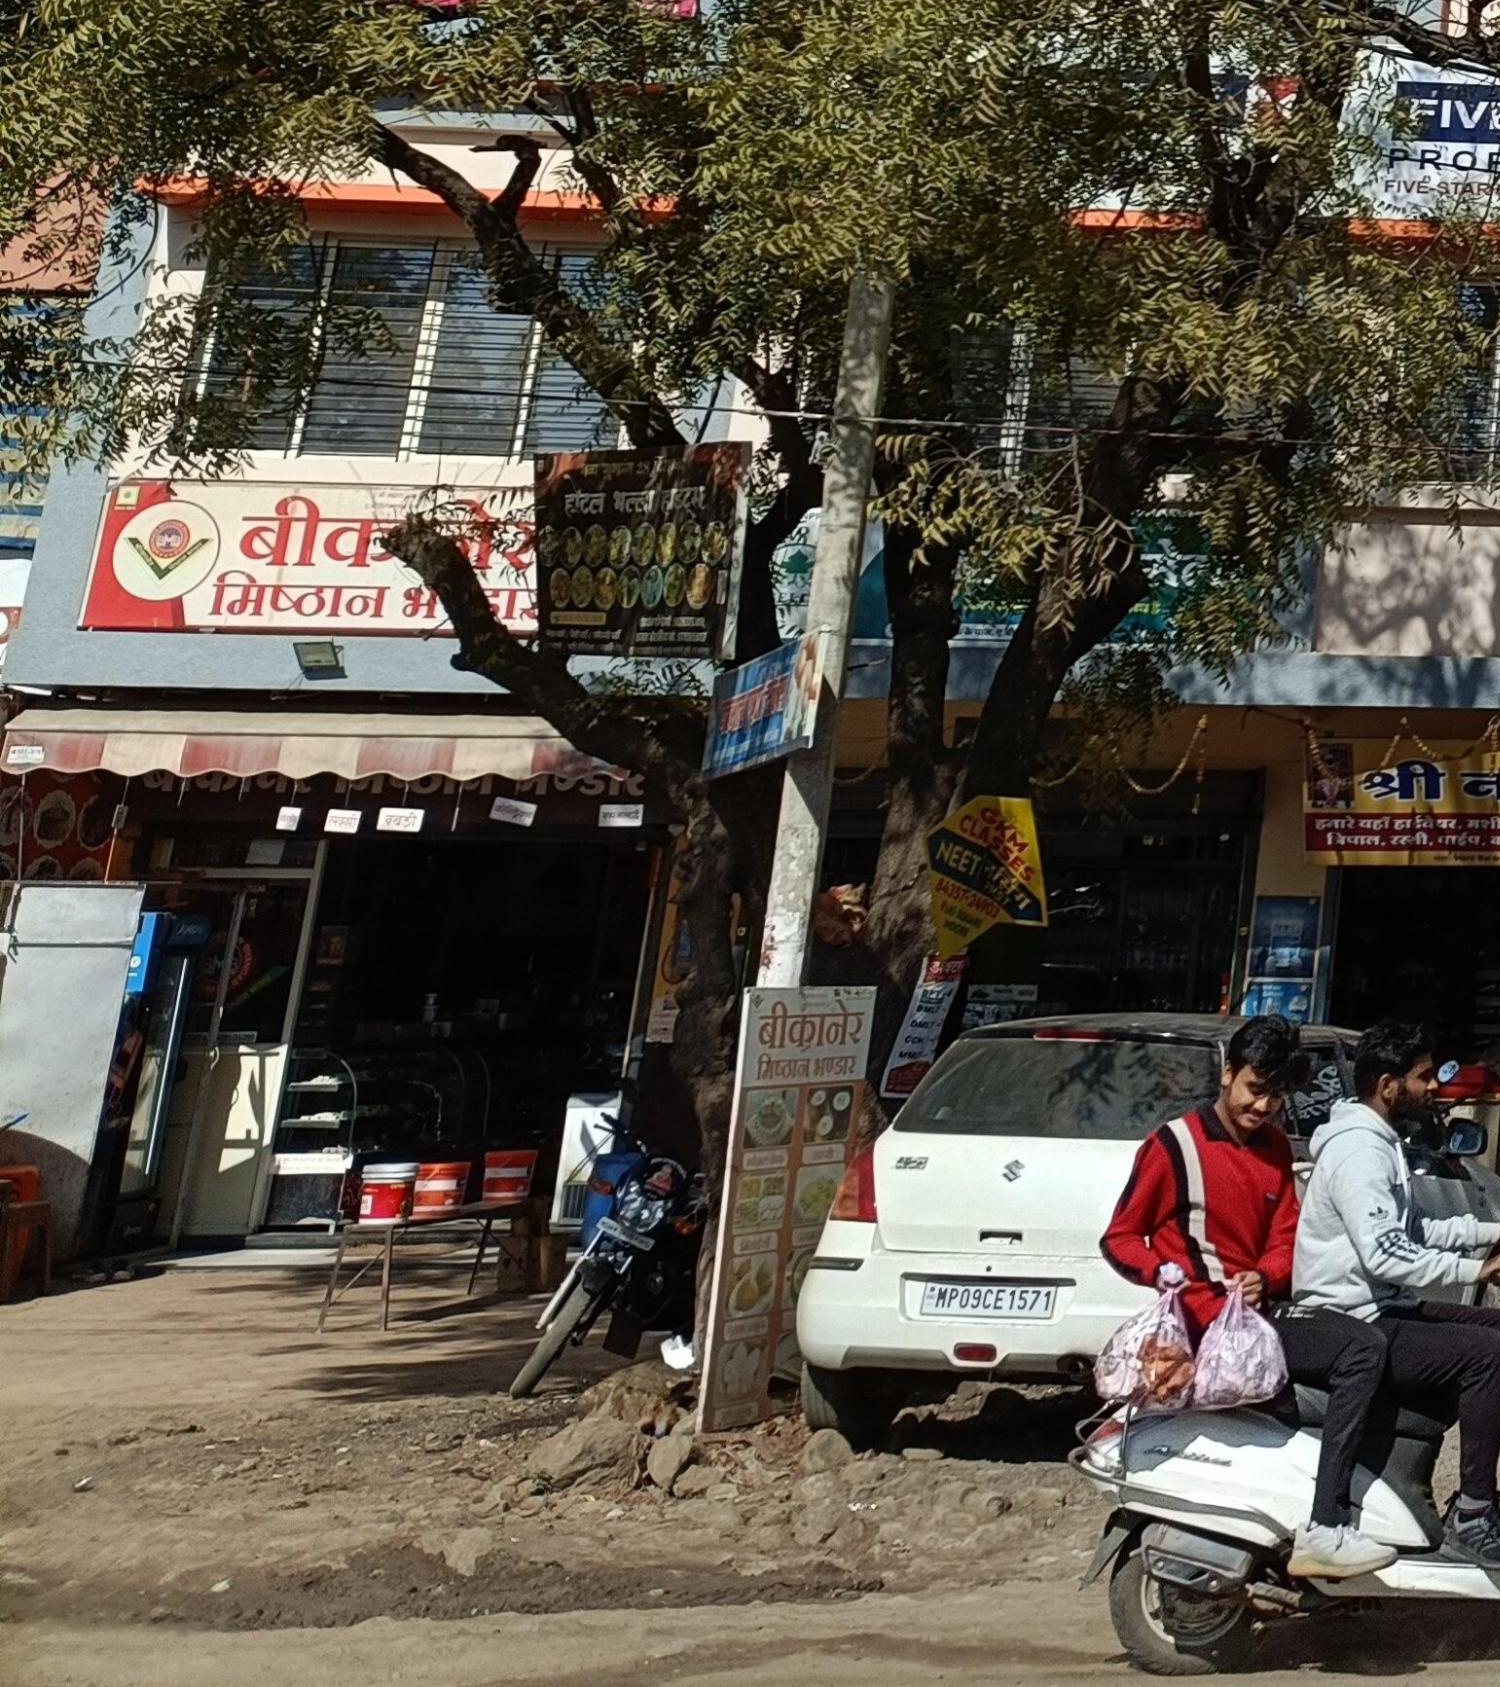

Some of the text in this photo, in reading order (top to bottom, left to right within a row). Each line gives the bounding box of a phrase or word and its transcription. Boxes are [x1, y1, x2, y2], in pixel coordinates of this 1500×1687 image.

[207, 570, 391, 618] मिष्ठान
[1363, 759, 1444, 801] श्री
[935, 840, 983, 876] NEET
[960, 815, 1035, 882] CLASSES
[758, 998, 866, 1051] बीकानेर
[757, 1052, 810, 1081] मिष्ठान
[813, 1054, 857, 1078] भण्डार
[935, 1287, 1052, 1312] MP09CE1571
